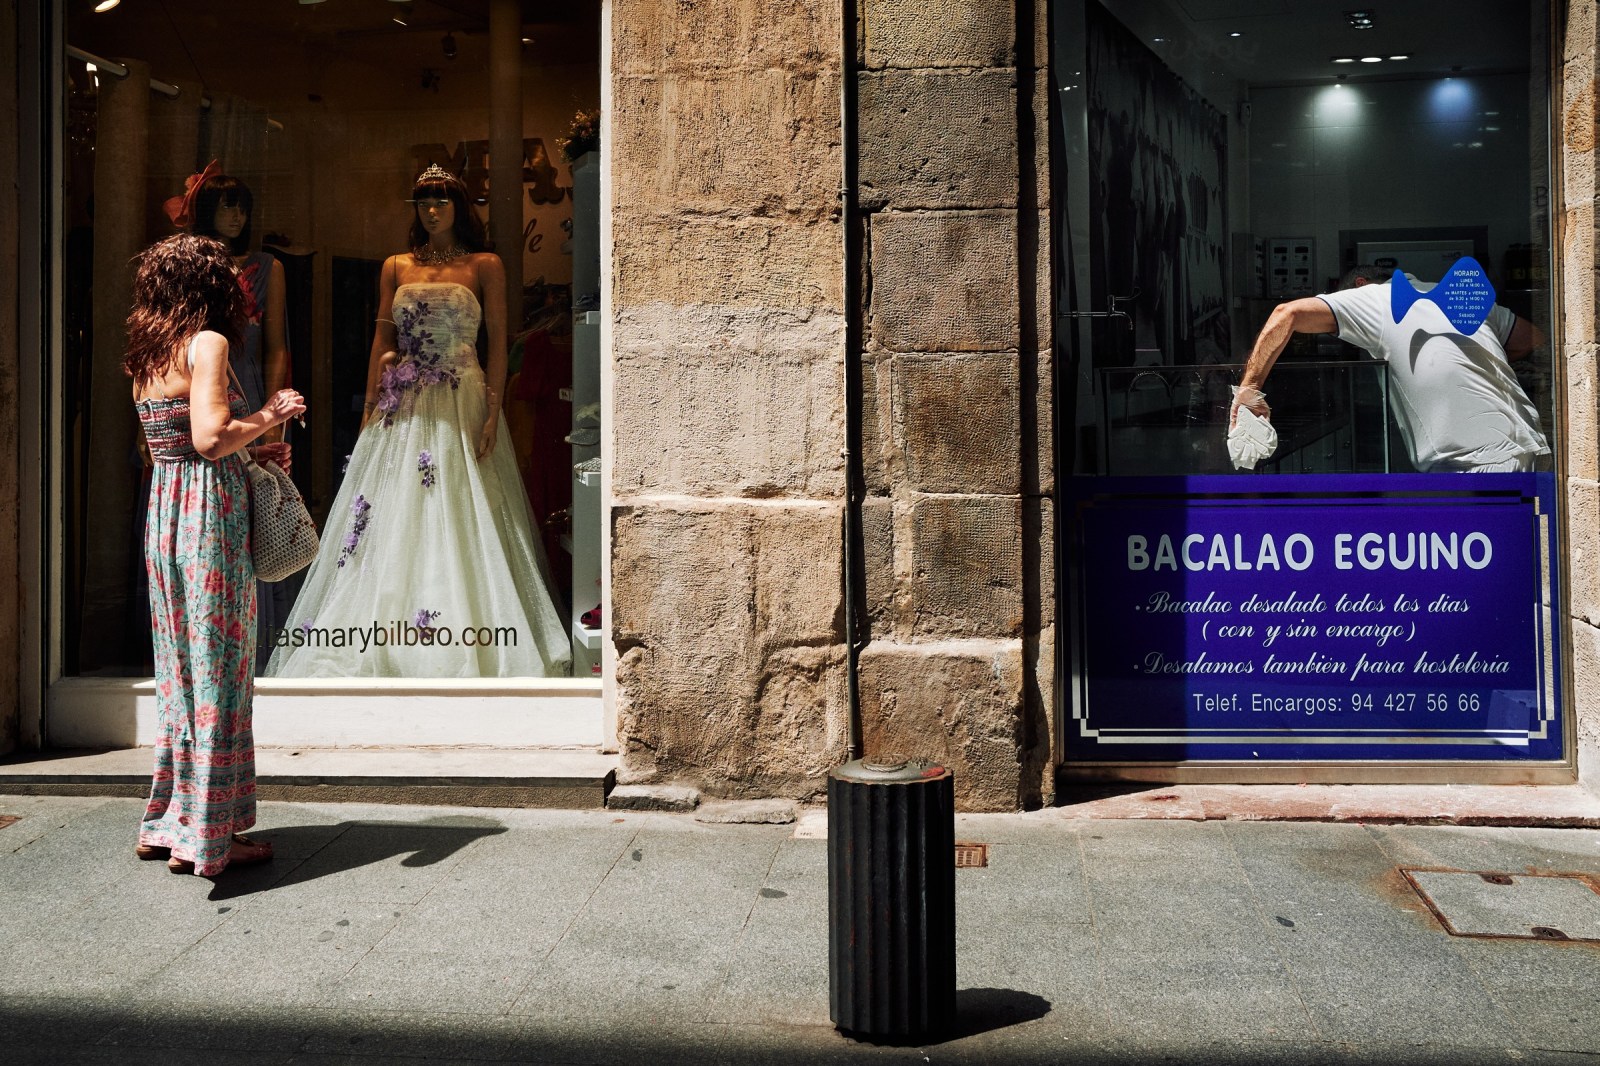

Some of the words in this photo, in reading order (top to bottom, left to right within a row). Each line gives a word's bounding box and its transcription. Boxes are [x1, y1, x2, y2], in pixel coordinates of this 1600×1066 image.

[1127, 533, 1314, 572] BACALAO
[1334, 531, 1493, 571] EGUINO
[1145, 590, 1232, 613] Bacalao
[1240, 591, 1328, 613] desalado
[1334, 593, 1385, 613] todos
[1393, 593, 1420, 613] los
[1218, 625, 1255, 638] con
[1262, 624, 1281, 648] y
[1285, 618, 1318, 638] sin
[1143, 651, 1255, 674] Desalamos
[1262, 652, 1347, 674] también
[1350, 652, 1405, 682] para
[1192, 693, 1242, 712] Telef.
[1252, 693, 1342, 716] Encargos:
[1351, 693, 1373, 712] 94
[1383, 693, 1416, 712] 427
[1427, 693, 1448, 712] 56
[1458, 693, 1480, 712] 66
